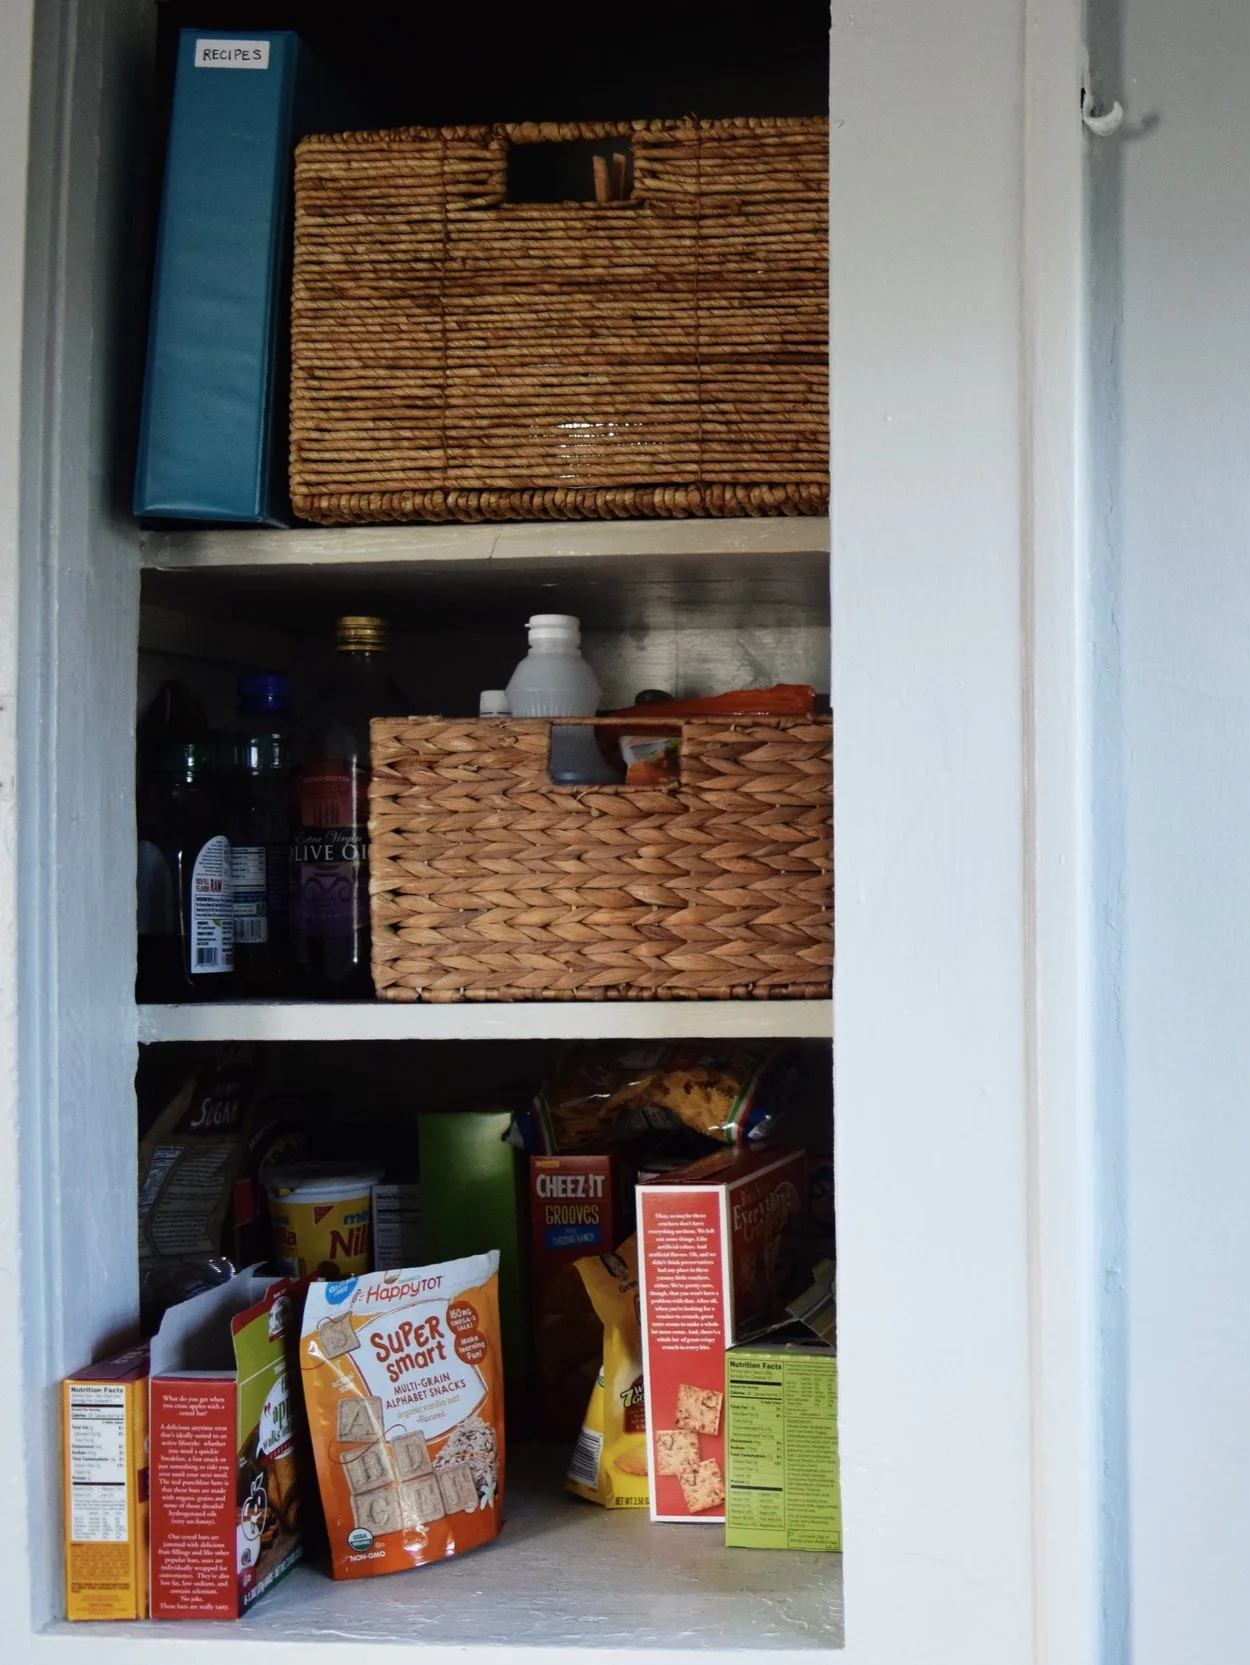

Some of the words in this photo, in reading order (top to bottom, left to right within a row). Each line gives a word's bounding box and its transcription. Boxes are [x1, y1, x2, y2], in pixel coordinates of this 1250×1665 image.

[203, 49, 262, 61] RECIPES
[461, 1336, 479, 1346] Make
[386, 1341, 446, 1382] smart
[467, 1351, 482, 1360] Fun!
[394, 1372, 450, 1396] MULTI-GRAIN
[386, 1388, 428, 1410] ALPHABET
[429, 1379, 466, 1397] SNACKS
[396, 1407, 424, 1420] organic
[424, 1400, 446, 1412] vanilla
[350, 1551, 386, 1562] NON-GMO
